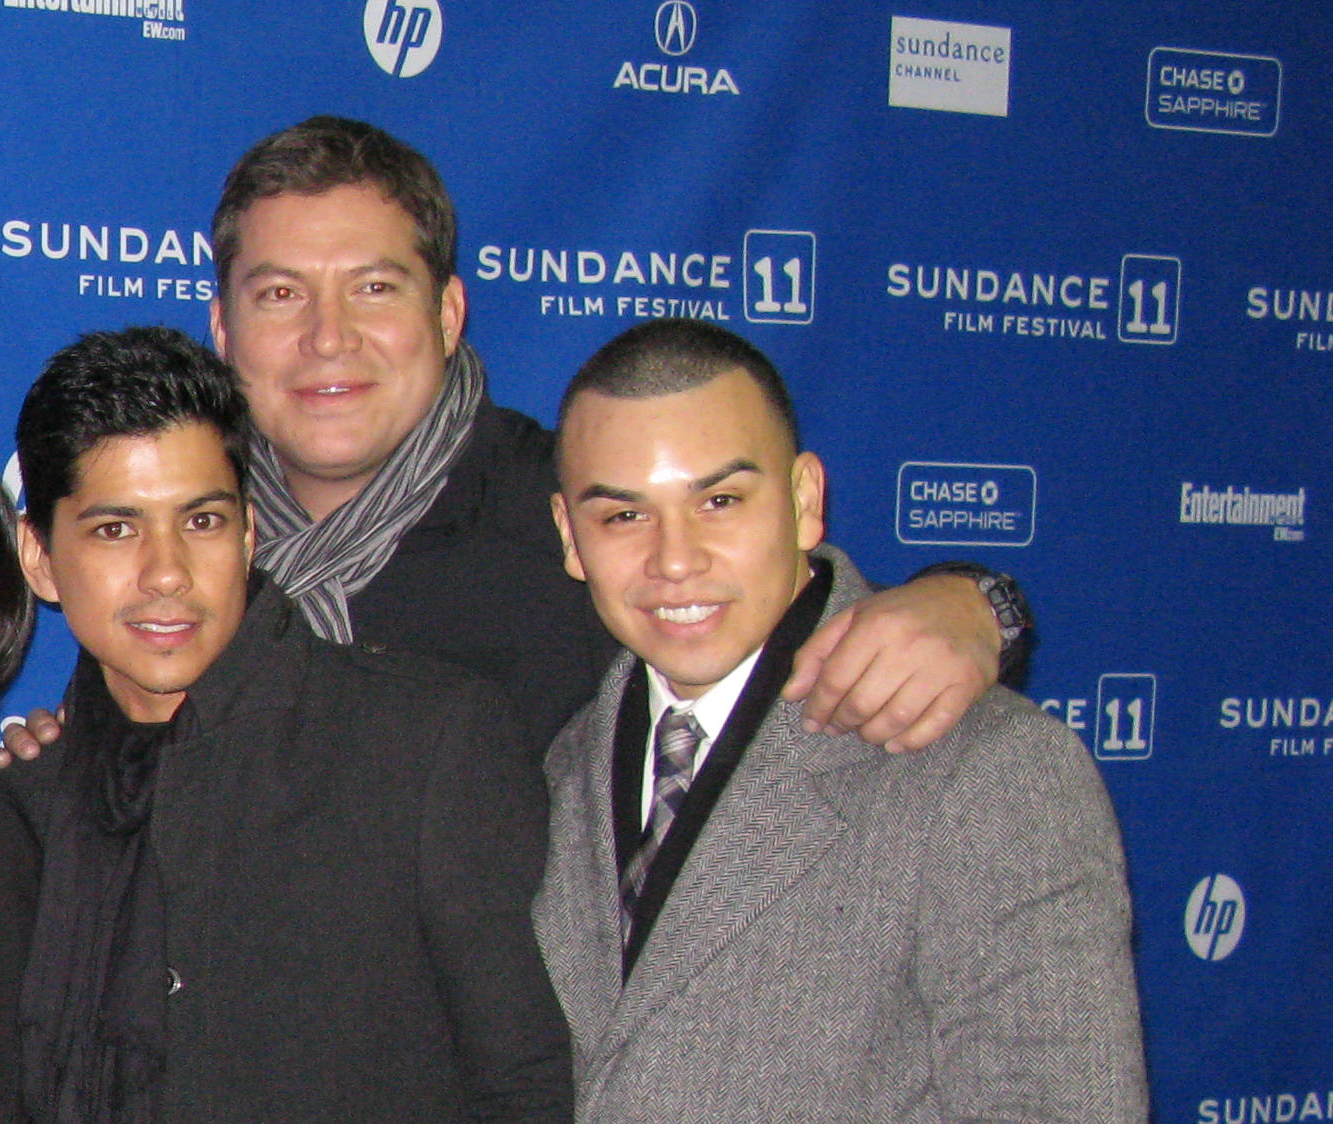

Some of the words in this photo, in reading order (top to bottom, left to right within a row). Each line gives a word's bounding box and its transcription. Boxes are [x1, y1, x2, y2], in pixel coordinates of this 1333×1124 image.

[143, 21, 185, 41] EW.com
[374, 0, 432, 77] hp
[896, 31, 1006, 64] sundance
[614, 61, 740, 95] ACURA
[895, 63, 961, 82] CHANNEL
[1160, 65, 1224, 91] CHASE
[1158, 94, 1262, 120] SAPPHIRE
[476, 245, 732, 288] SUNDANCE
[79, 275, 144, 298] FILM
[754, 256, 807, 314] 11
[887, 264, 1110, 309] SUNDANCE
[541, 295, 605, 316] FILM
[617, 298, 731, 320] FESTIVAL
[1126, 280, 1171, 335] 11
[944, 311, 994, 332] FILM
[1002, 315, 1107, 340] FESTIVAL
[910, 480, 978, 503] CHASE
[1180, 482, 1305, 526] Entertainment
[909, 509, 1016, 531] SAPPHIRE
[1103, 698, 1147, 751] 11
[1270, 738, 1314, 756] FILM
[1193, 874, 1238, 960] hp
